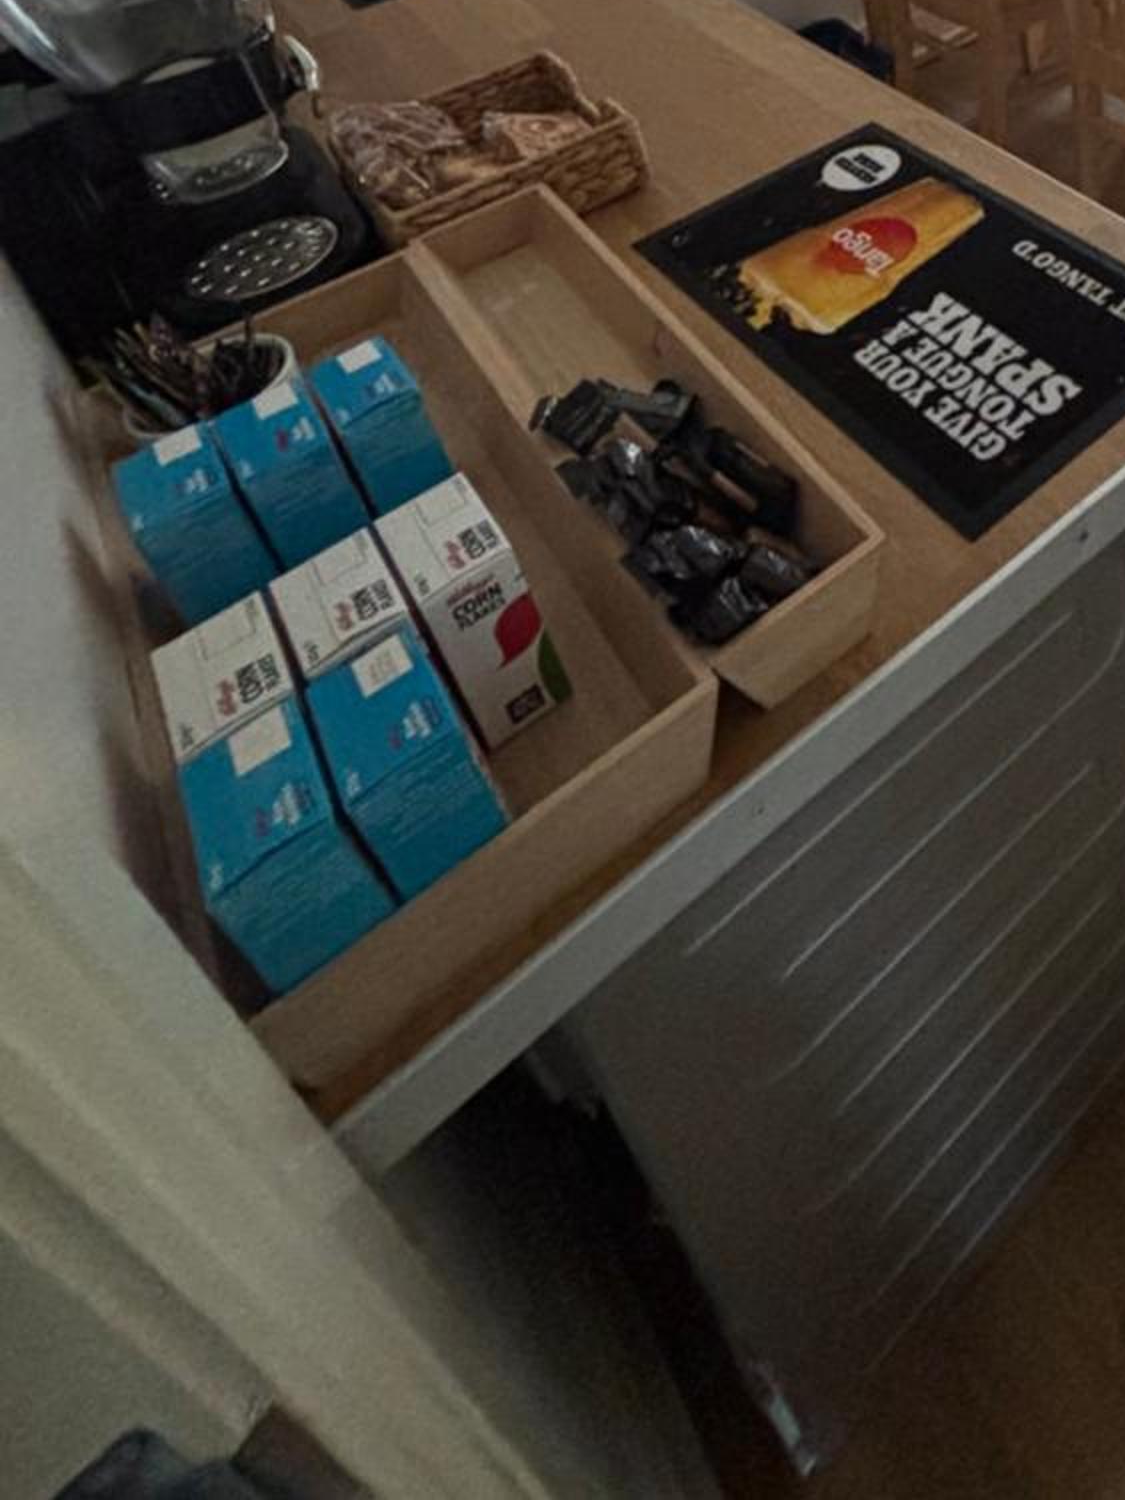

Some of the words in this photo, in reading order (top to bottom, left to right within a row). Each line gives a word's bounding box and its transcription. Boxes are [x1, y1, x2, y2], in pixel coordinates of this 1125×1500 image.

[832, 227, 895, 279] Tango
[882, 320, 920, 347] A
[906, 291, 1083, 416] SPANK
[852, 338, 937, 409] YOUR
[901, 337, 1036, 441] TONGUE
[923, 394, 1007, 461] GIVE
[452, 581, 504, 621] CORN
